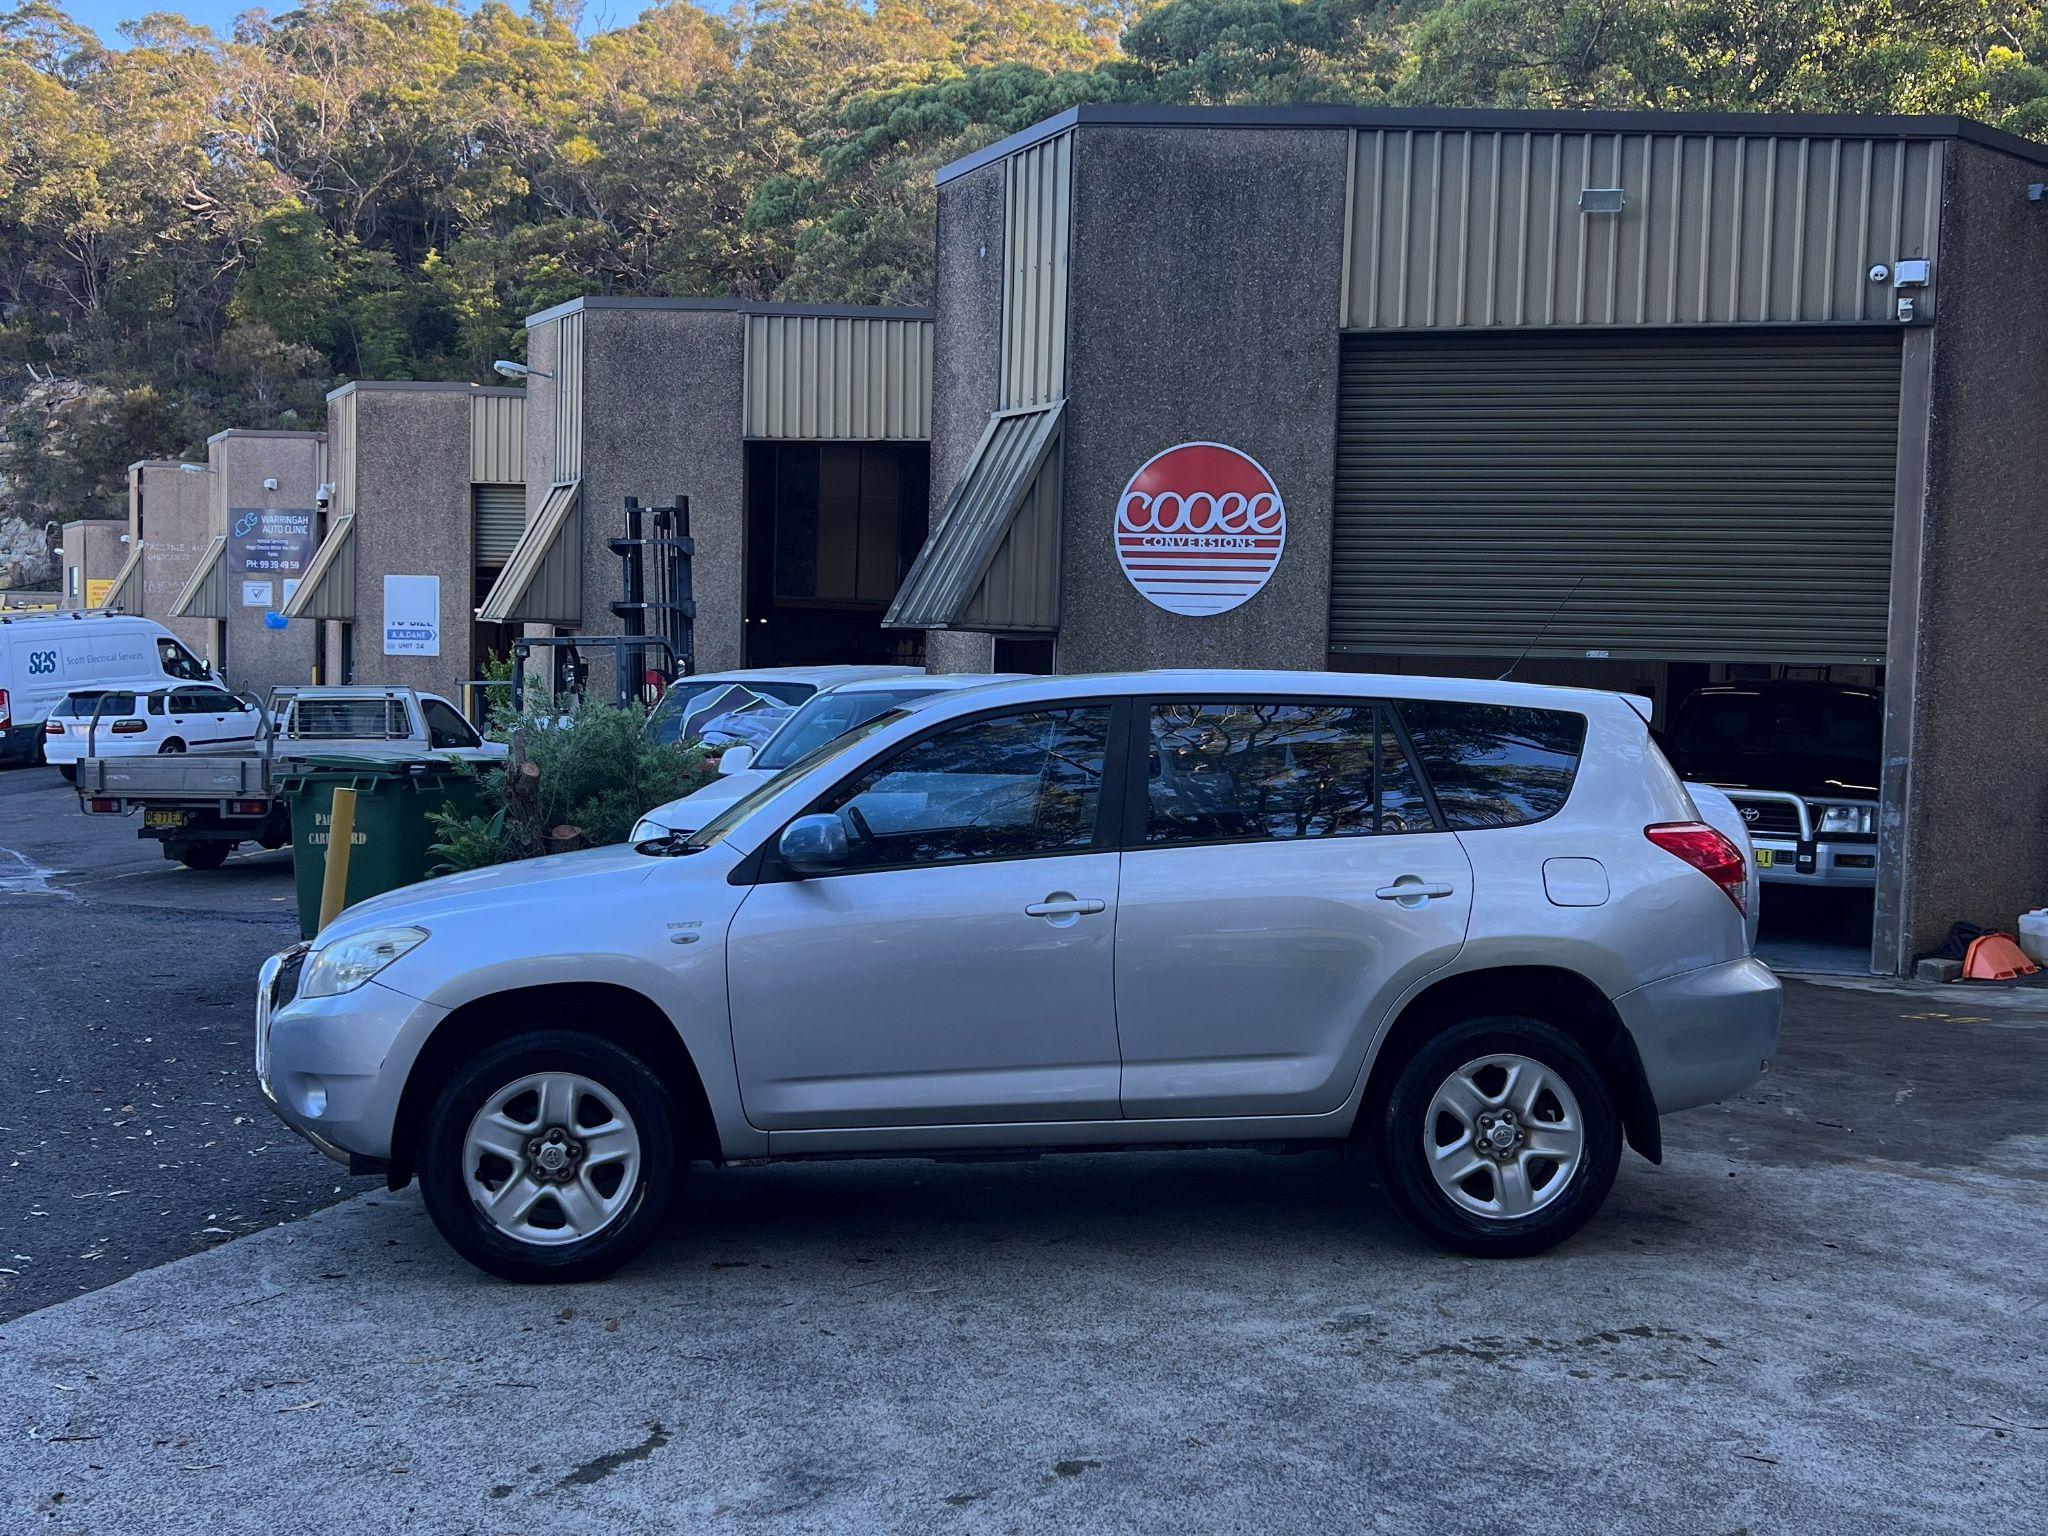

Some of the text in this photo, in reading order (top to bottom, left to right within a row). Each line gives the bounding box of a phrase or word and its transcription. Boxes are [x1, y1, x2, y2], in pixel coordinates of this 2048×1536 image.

[1119, 491, 1283, 534] cooee
[262, 516, 308, 524] WARRINGAH
[262, 525, 308, 534] AUTO CLINIC
[1142, 537, 1256, 548] CONVERSIONS
[260, 560, 269, 569] 99
[280, 560, 289, 569] 49
[66, 651, 144, 666] Scott Electrical Services
